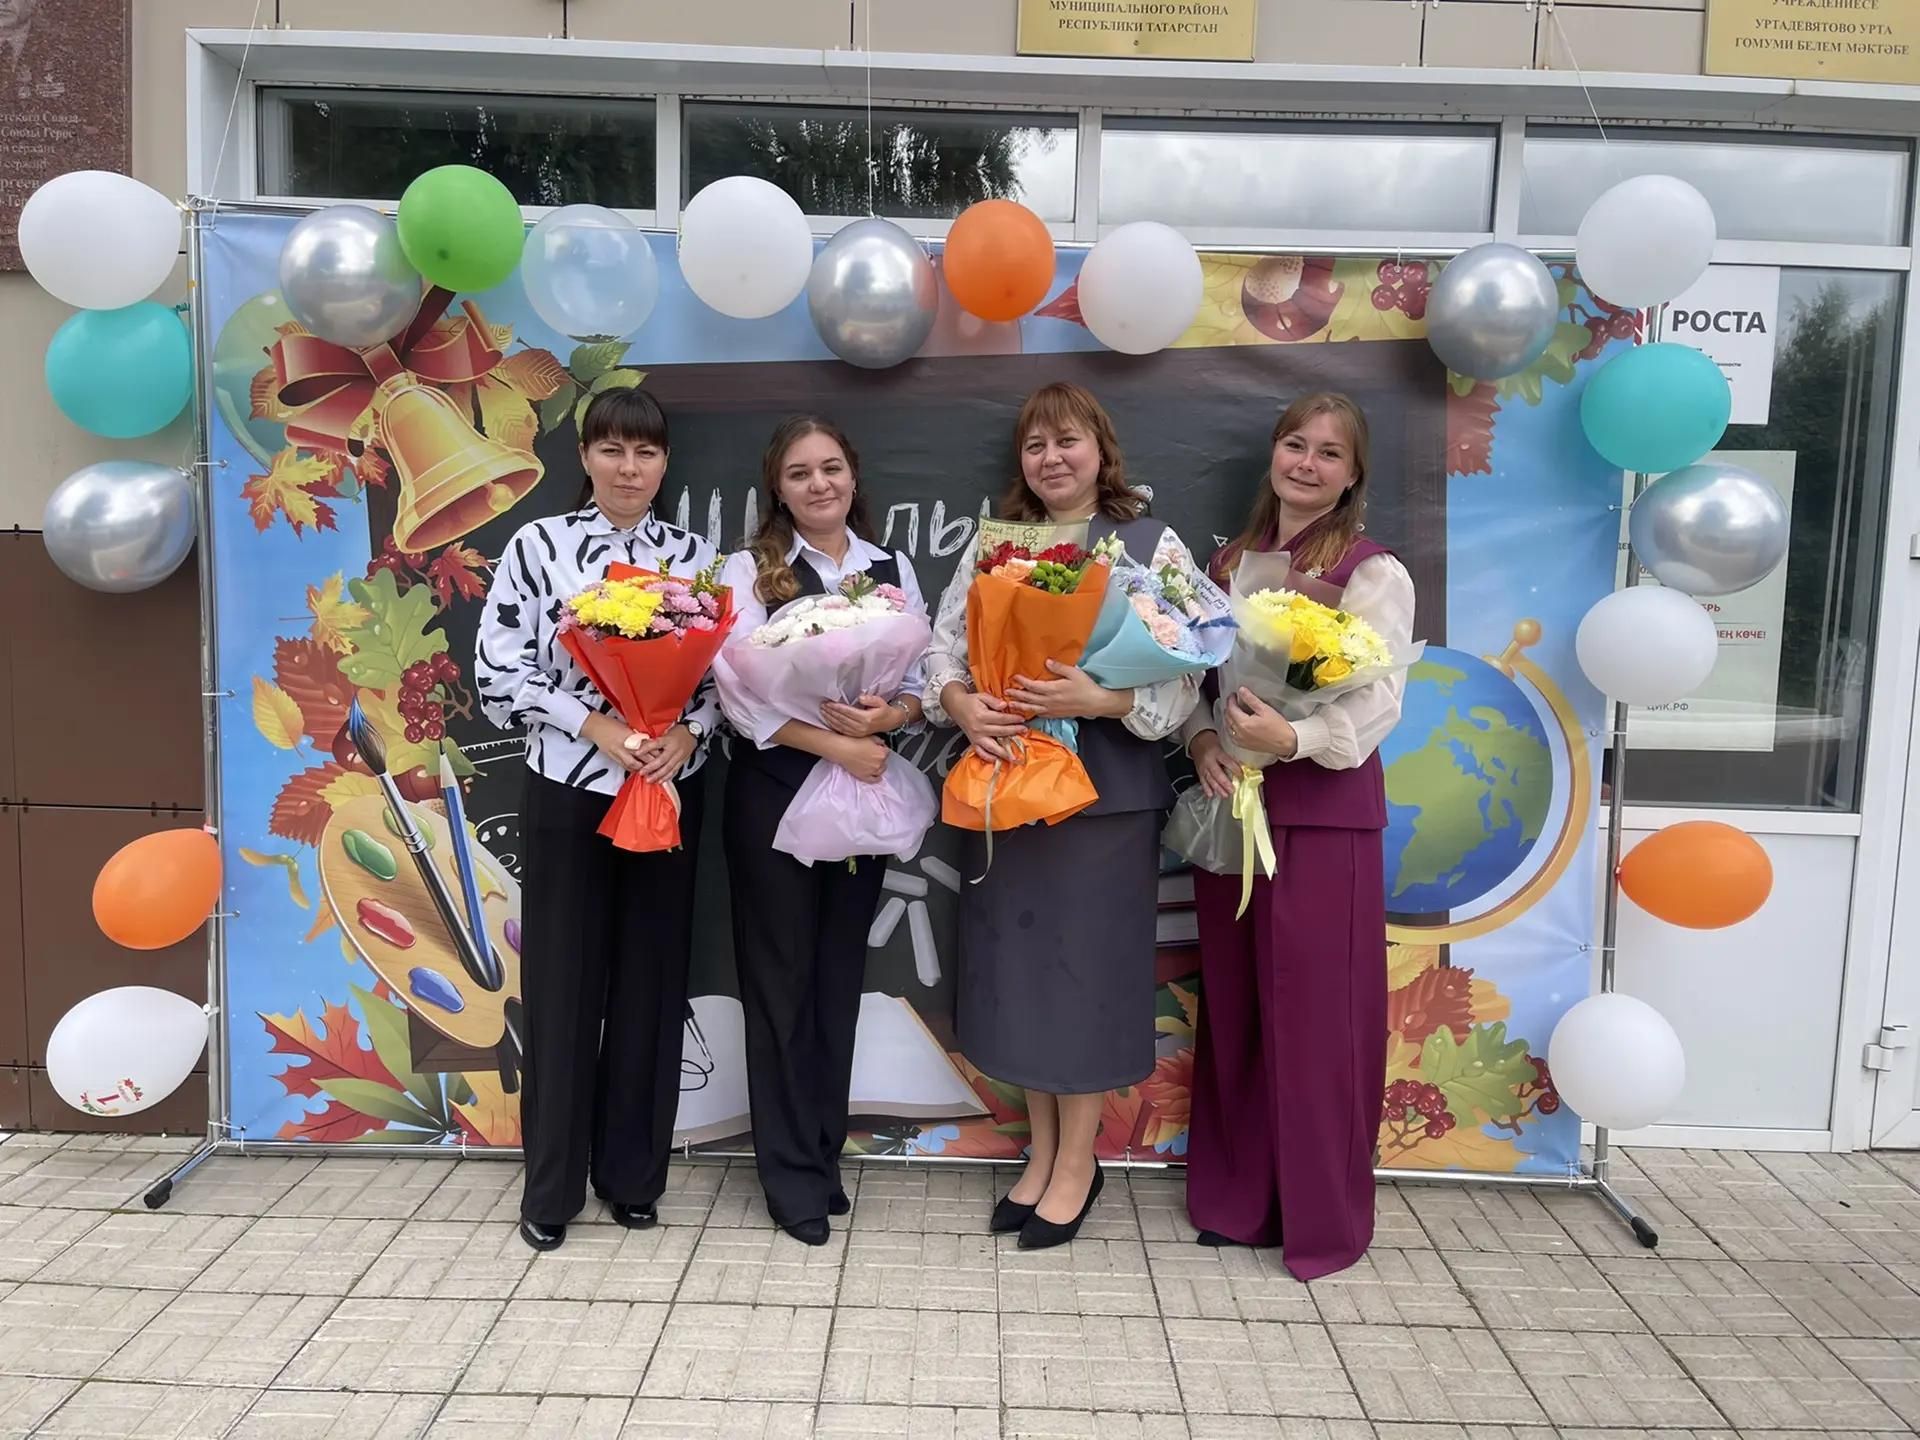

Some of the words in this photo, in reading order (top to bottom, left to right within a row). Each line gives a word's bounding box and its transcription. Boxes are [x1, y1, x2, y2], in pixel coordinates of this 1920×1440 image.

[1050, 0, 1175, 15] МУНИЦИПАЛЬНОГО
[1179, 3, 1228, 15] РАЙОНА
[1059, 19, 1143, 32] РЕСПУБЛИКИ
[1146, 22, 1218, 33] ТАТАРСТАН
[1755, 18, 1856, 33] УРТАДЕВЯТОВО
[1860, 24, 1892, 35] УРТА
[1735, 37, 1794, 49] ГОМУМИ
[1797, 40, 1841, 52] БЕЛЕМ
[1847, 42, 1910, 55] МӘКТӘБЕ
[1672, 310, 1767, 333] РОСТА
